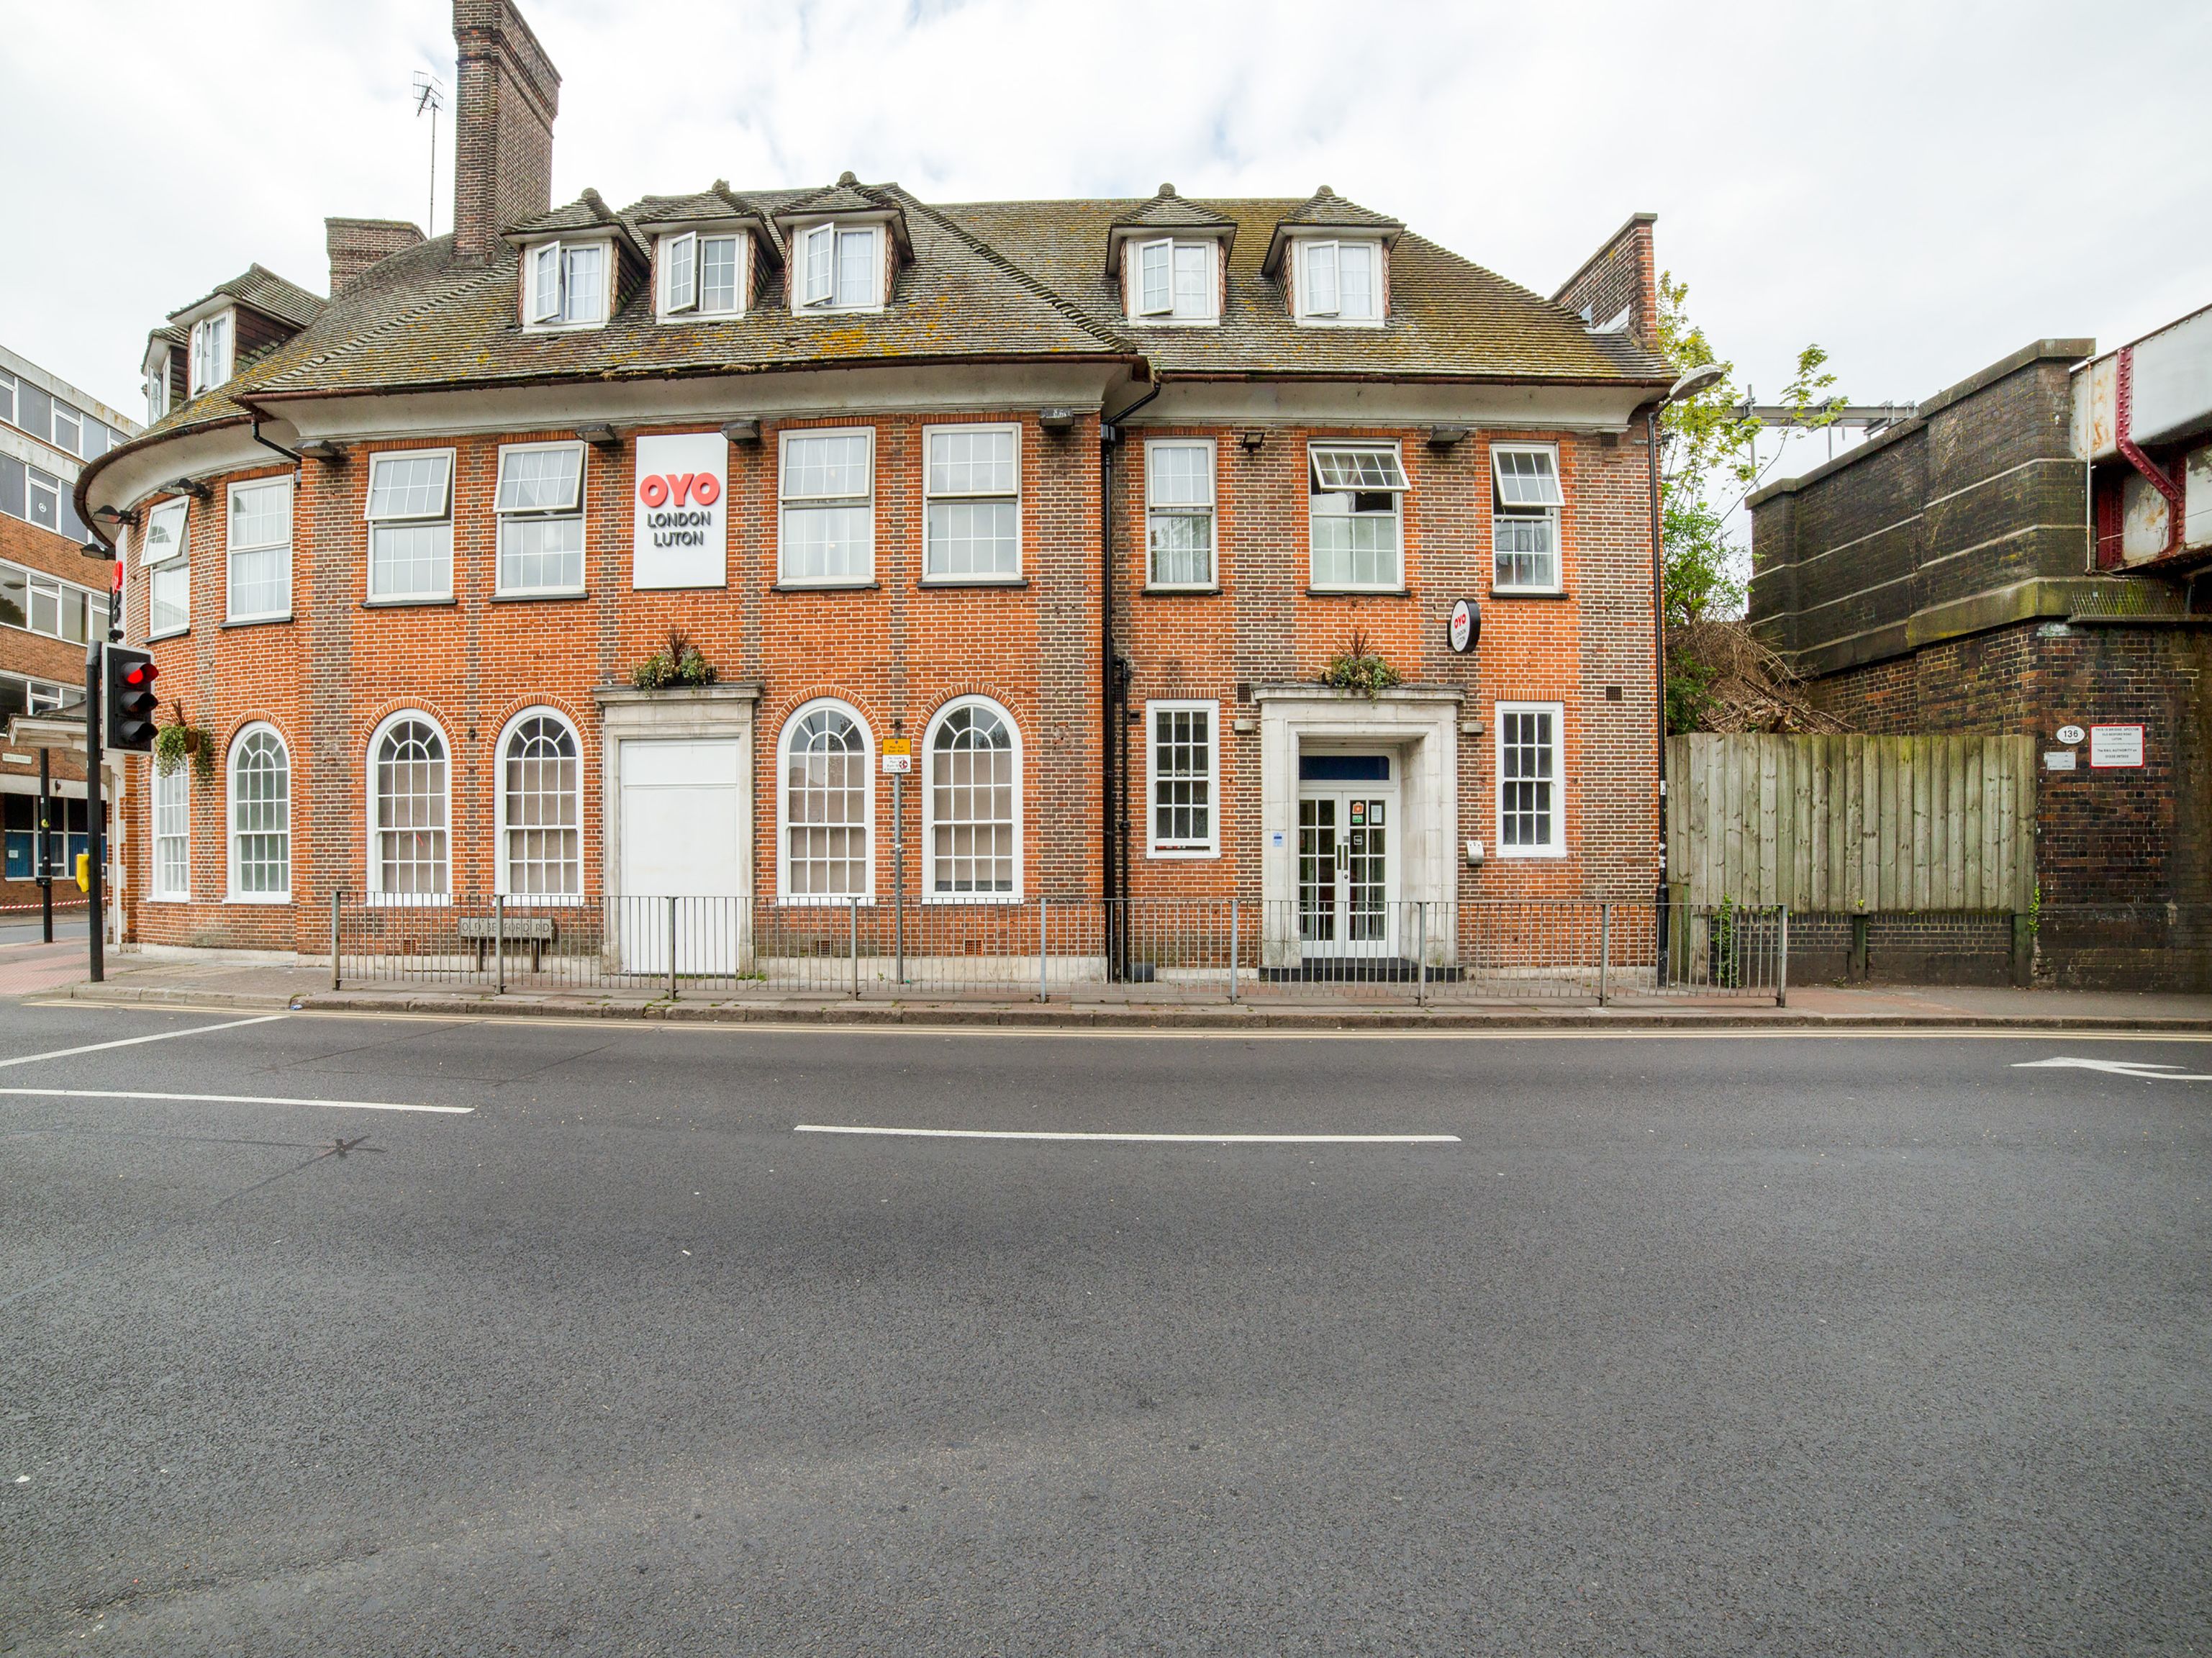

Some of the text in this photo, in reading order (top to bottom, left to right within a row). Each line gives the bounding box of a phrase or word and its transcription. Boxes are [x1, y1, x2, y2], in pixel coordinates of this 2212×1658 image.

[640, 472, 720, 508] OYO
[647, 511, 711, 527] LONDON
[653, 530, 704, 547] LUTON
[1454, 613, 1466, 629] OYO
[488, 923, 530, 933] BEFORD
[536, 923, 550, 932] RD
